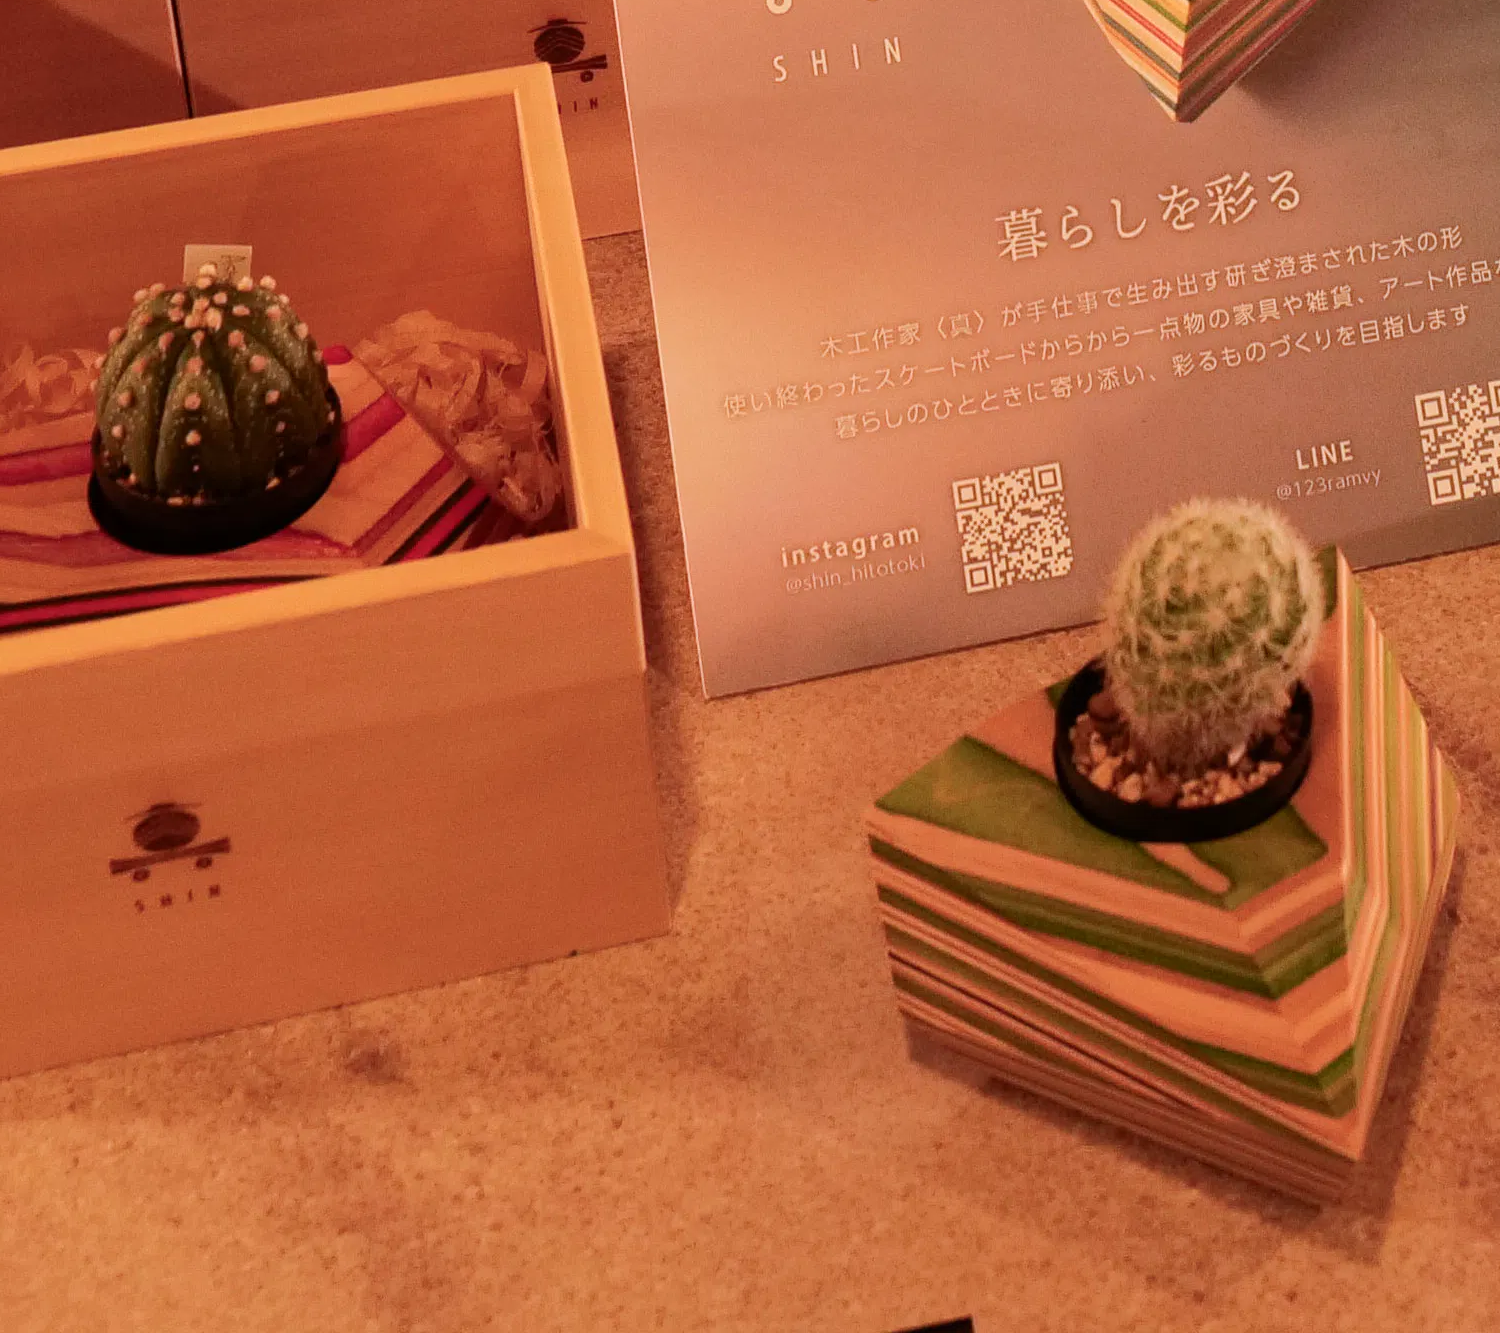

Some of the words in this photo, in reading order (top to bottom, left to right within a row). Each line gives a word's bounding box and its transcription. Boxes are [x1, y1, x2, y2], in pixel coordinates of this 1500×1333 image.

[772, 36, 902, 83] SHIN
[993, 168, 1303, 263] 暮らしを彩る
[1295, 439, 1354, 471] LINE
[1275, 468, 1382, 501] @123ramvy
[780, 526, 920, 569] instagram
[785, 551, 926, 594] @shin_hitotoki
